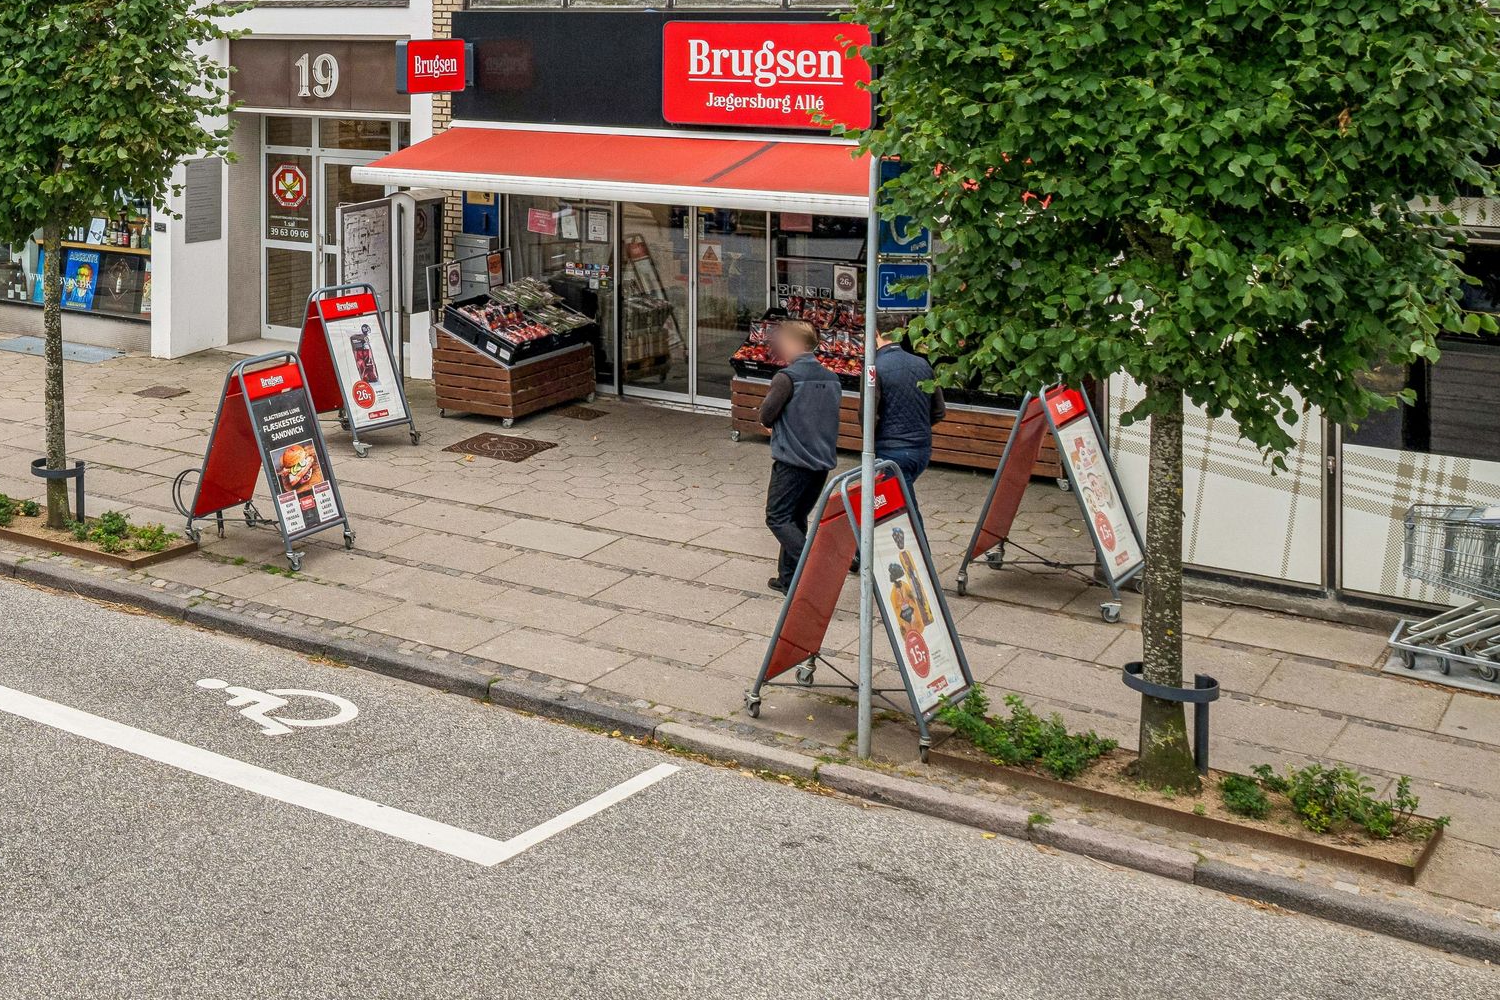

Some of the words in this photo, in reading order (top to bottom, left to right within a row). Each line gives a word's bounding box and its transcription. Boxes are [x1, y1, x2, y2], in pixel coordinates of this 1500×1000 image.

[413, 55, 458, 79] Brugsen
[688, 39, 844, 88] Brugsen
[295, 53, 339, 98] 19
[706, 92, 791, 114] Jægersborg
[794, 93, 825, 110] Allé
[270, 227, 279, 236] 39
[279, 228, 289, 237] 63
[289, 229, 299, 238] 09
[299, 230, 309, 239] 06
[335, 302, 359, 312] Brugsen
[260, 375, 284, 389] Brugsen
[262, 414, 307, 433] FLÆSKESTEGS-
[271, 425, 305, 442] SANDWICH
